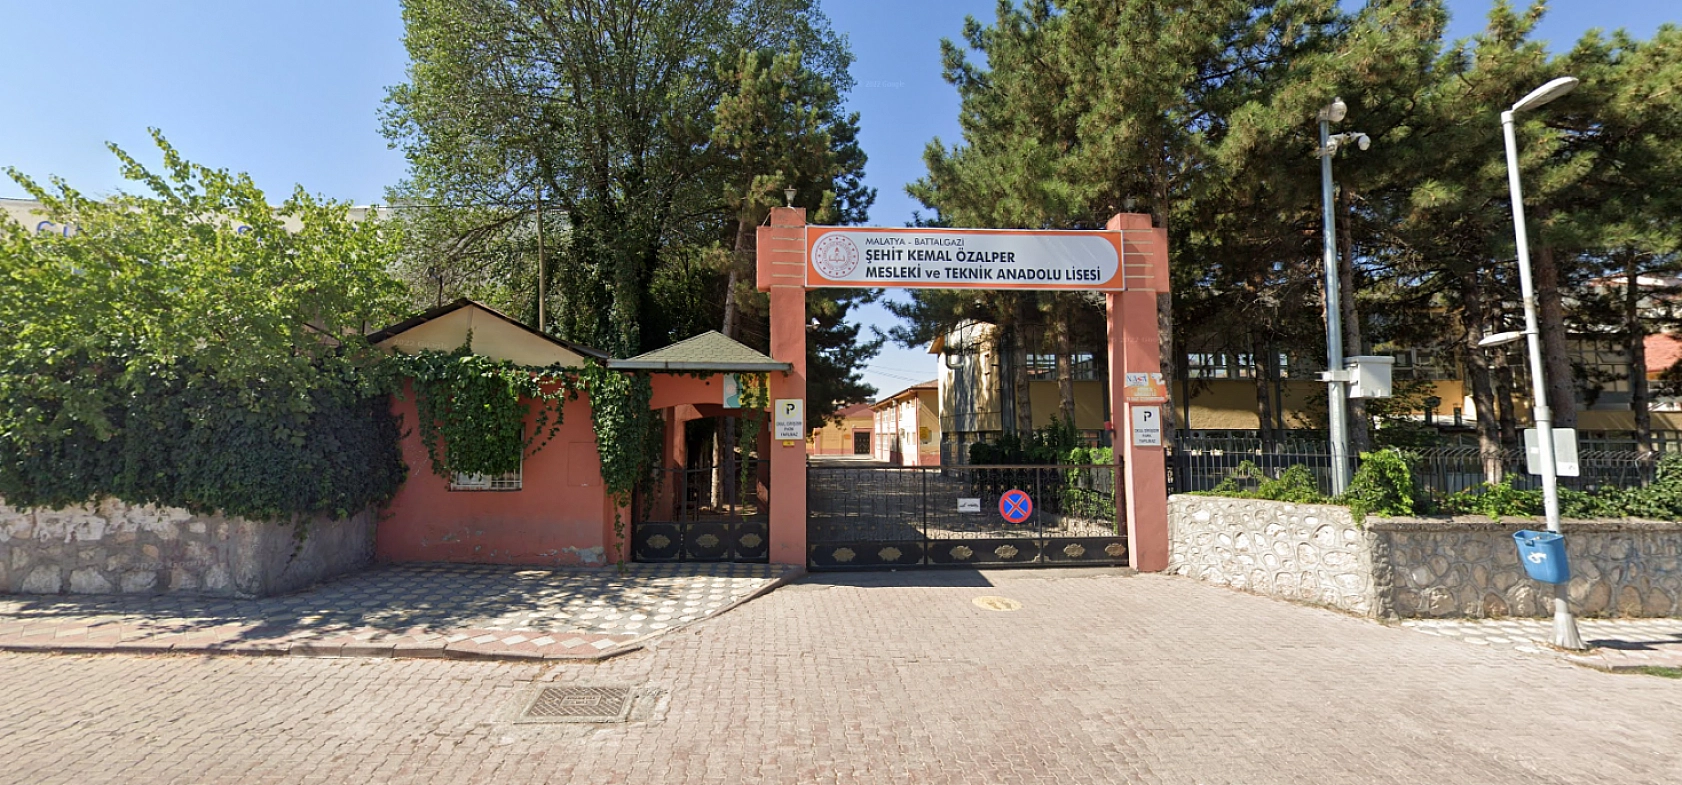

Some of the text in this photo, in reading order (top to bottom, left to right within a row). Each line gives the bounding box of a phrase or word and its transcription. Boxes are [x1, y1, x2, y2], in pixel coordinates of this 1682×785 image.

[865, 237, 906, 246] MALATYA
[914, 237, 965, 247] BATTALGAZİ
[865, 246, 903, 264] ŞEHİT
[907, 249, 952, 262] KEMAL
[956, 247, 1016, 263] ÖZALPER
[865, 263, 1101, 281] MESLEKİ ve TEKNİK ANADOLU LİSESİ
[1144, 411, 1152, 422] P
